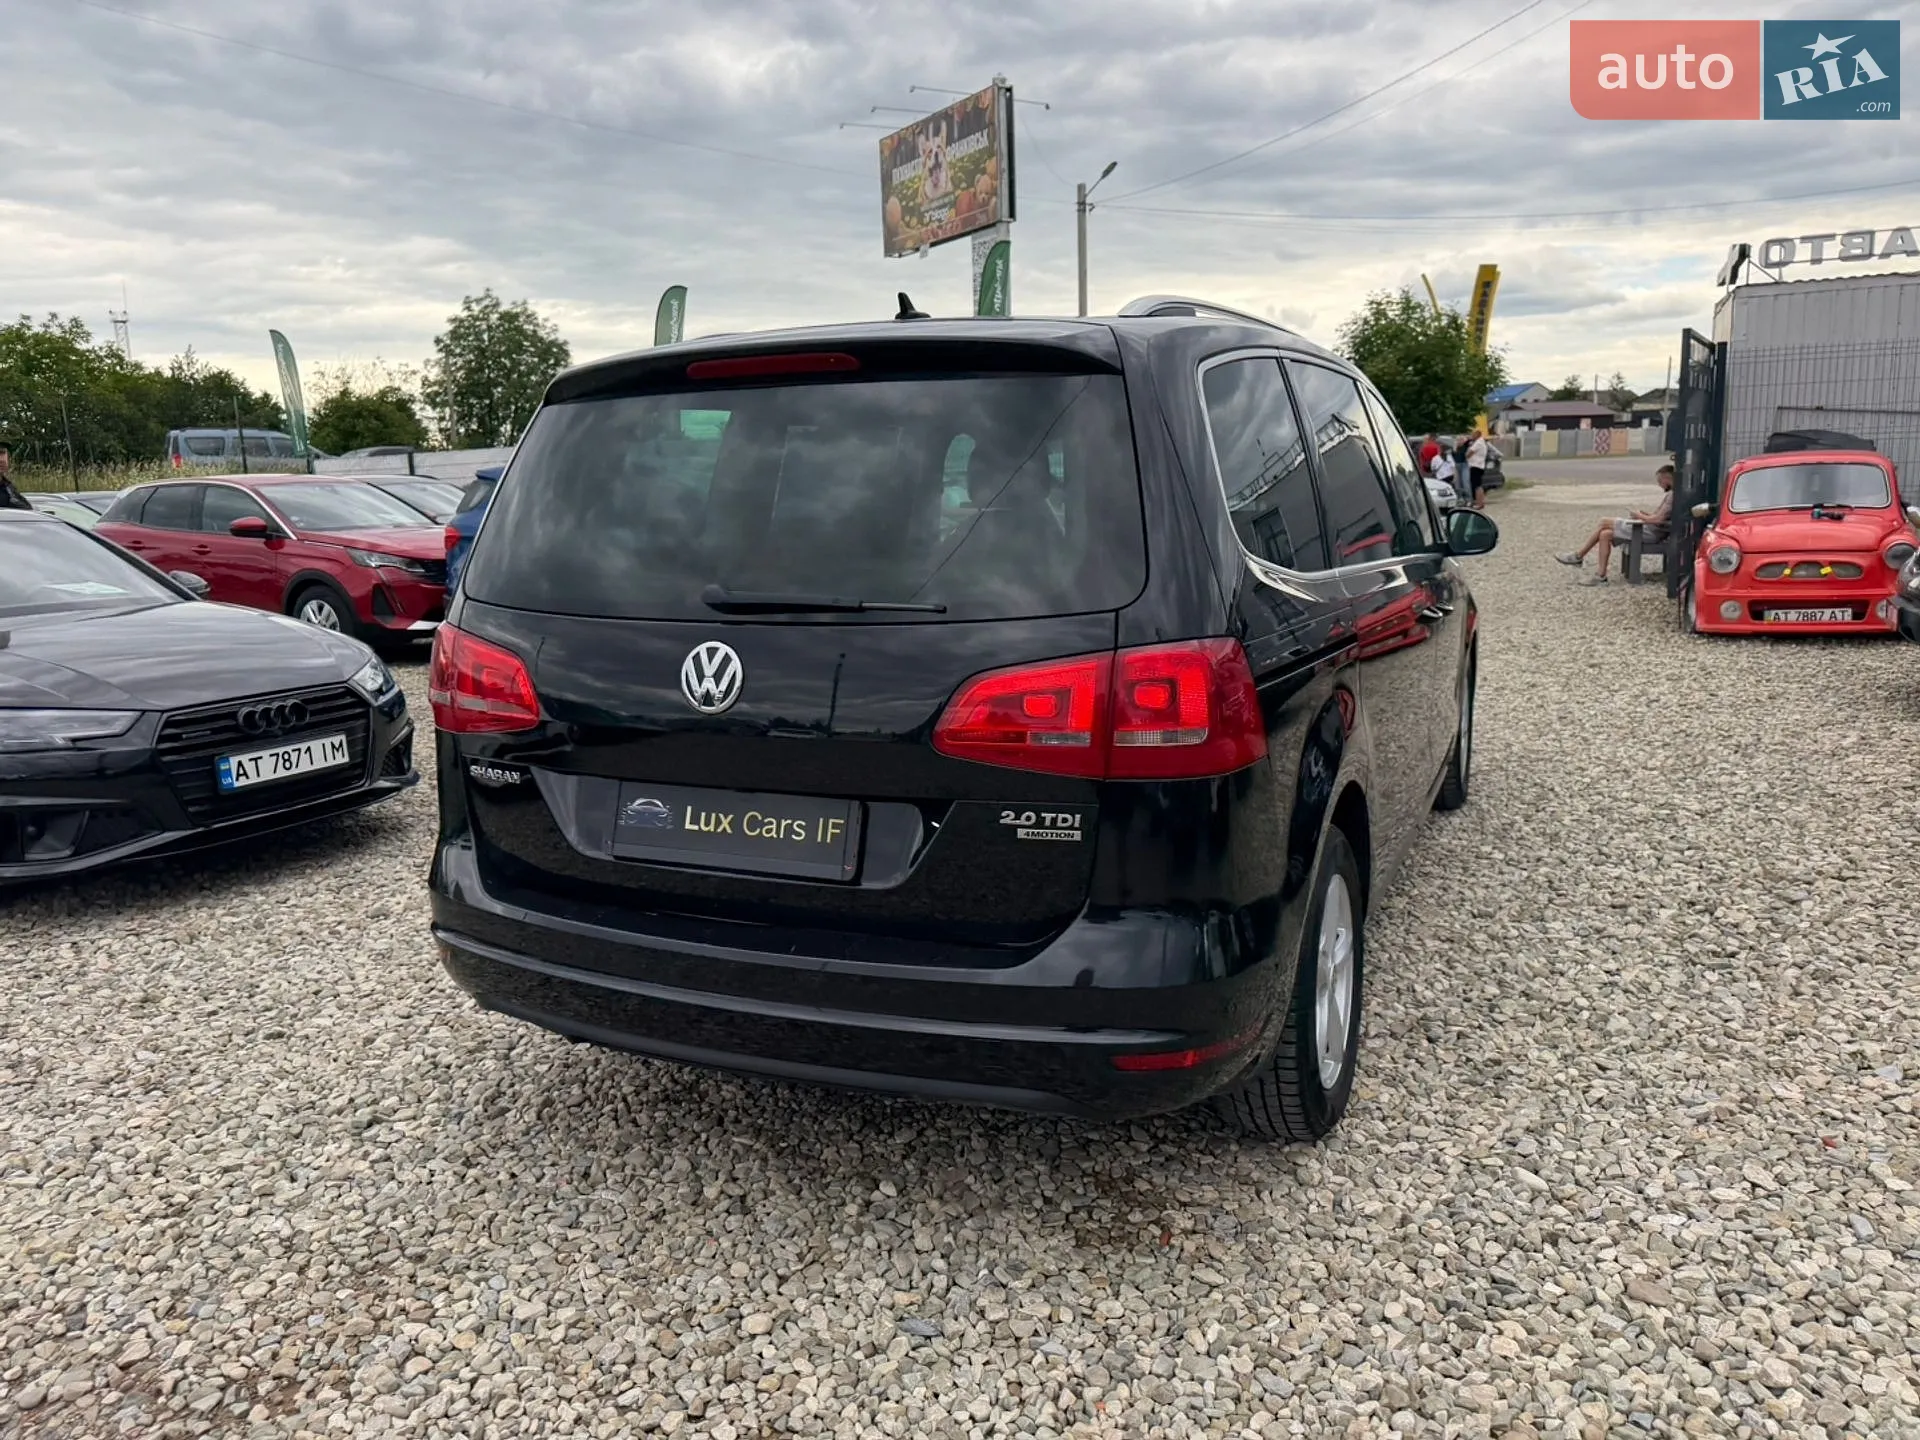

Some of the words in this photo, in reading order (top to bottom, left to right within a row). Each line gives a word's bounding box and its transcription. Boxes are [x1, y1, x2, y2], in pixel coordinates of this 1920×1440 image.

[1773, 611, 1791, 621] AT
[1794, 610, 1824, 621] 7887
[1829, 609, 1848, 621] AT
[235, 756, 263, 782] AT
[269, 745, 314, 775] 7871
[322, 739, 346, 762] IM
[469, 765, 520, 784] SHARAN
[684, 805, 734, 834] Lux
[743, 811, 806, 841] Cars
[816, 817, 845, 843] IF
[1041, 812, 1082, 828] TDI
[1023, 830, 1075, 839] 4MOTION
